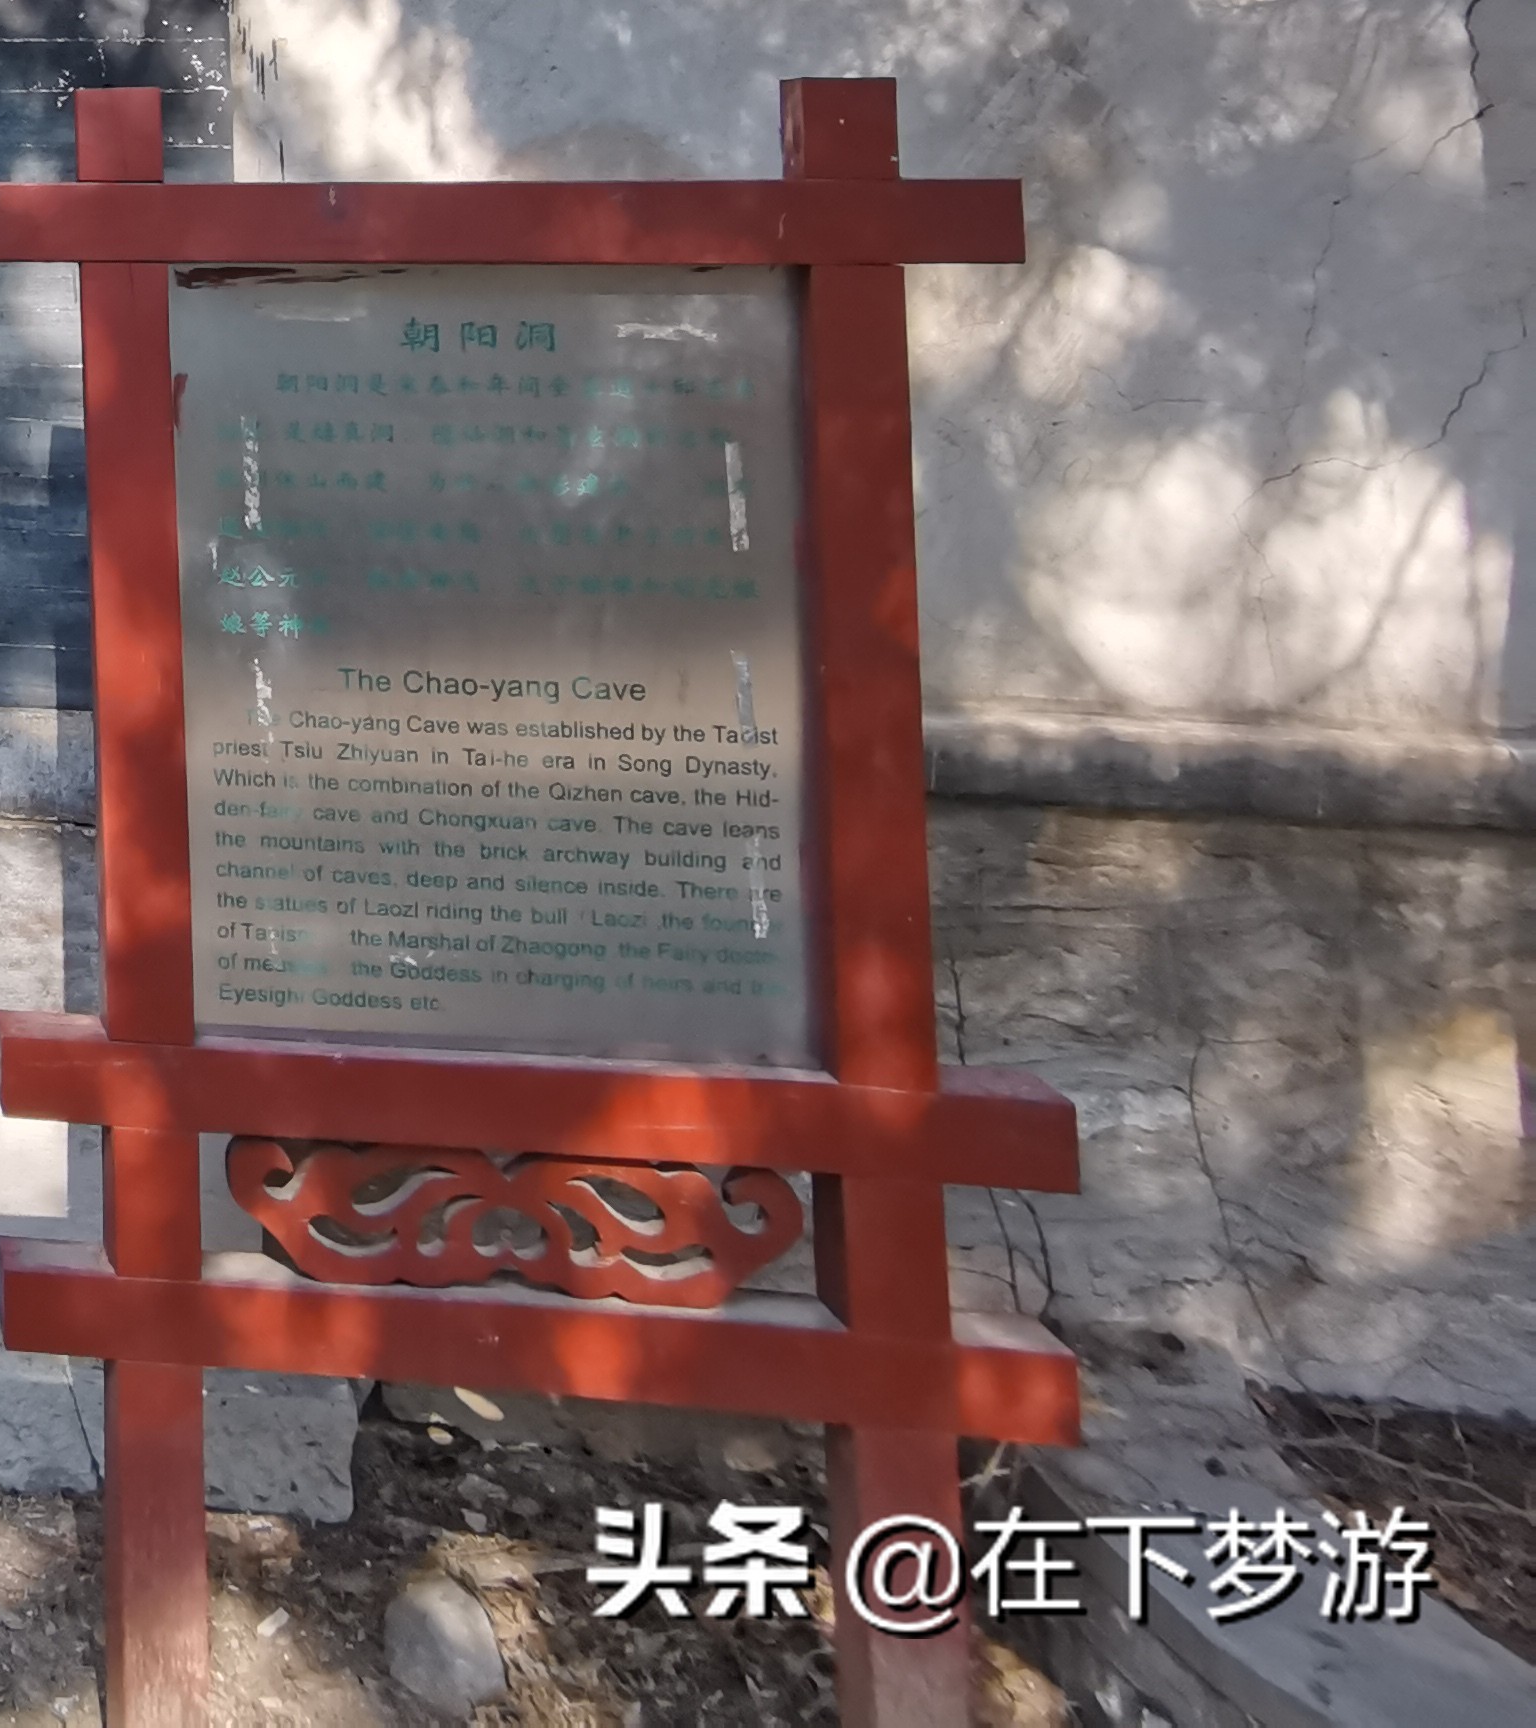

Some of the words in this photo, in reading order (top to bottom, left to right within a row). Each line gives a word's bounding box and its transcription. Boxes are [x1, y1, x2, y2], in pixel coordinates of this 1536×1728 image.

[400, 317, 556, 353] 朝阳洞
[338, 668, 392, 693] The
[403, 670, 560, 705] Chao-yang
[571, 676, 647, 702] Cave
[246, 709, 282, 726] Te
[289, 710, 401, 736] Chao-yang
[406, 715, 460, 735] Cave
[468, 721, 508, 737] was
[516, 720, 635, 742] established
[642, 723, 666, 745] by
[673, 724, 706, 743] the
[337, 742, 419, 766] Zhiyuan
[431, 747, 449, 765] in
[462, 747, 529, 768] Tai-he
[542, 753, 576, 769] era
[588, 753, 606, 771] in
[618, 753, 673, 778] Song
[213, 768, 276, 788] Which
[308, 773, 340, 791] the
[348, 775, 473, 798] combination
[481, 779, 501, 798] of
[508, 781, 540, 800] the
[548, 782, 623, 802] Qizhen
[694, 787, 726, 806] the
[736, 789, 780, 808] Hid-
[313, 806, 361, 823] cave
[371, 807, 408, 825] and
[418, 808, 537, 832] Chongxuan
[613, 815, 653, 835] The
[662, 820, 712, 838] cave
[723, 820, 780, 840] leans
[215, 830, 246, 848] the
[260, 834, 366, 855] mountains
[379, 838, 420, 857] with
[434, 840, 466, 858] the
[480, 842, 528, 861] brick
[543, 845, 630, 870] archway
[644, 849, 727, 874] building
[742, 854, 782, 872] and
[304, 865, 323, 882] of
[406, 870, 459, 892] deep
[467, 873, 505, 891] and
[515, 874, 588, 894] silence
[675, 880, 739, 901] There
[216, 892, 248, 909] the
[255, 894, 327, 914] satues
[336, 897, 357, 915] of
[426, 901, 482, 924] riding
[490, 905, 522, 922] the
[531, 906, 568, 925] bull
[217, 923, 236, 939] of
[350, 929, 383, 948] the
[388, 930, 470, 952] Marshal
[476, 934, 496, 952] of
[618, 941, 651, 960] the
[218, 953, 237, 971] of
[389, 961, 483, 983] Goddess
[491, 965, 508, 983] in
[515, 969, 606, 994] charging
[312, 988, 403, 1010] Goddess
